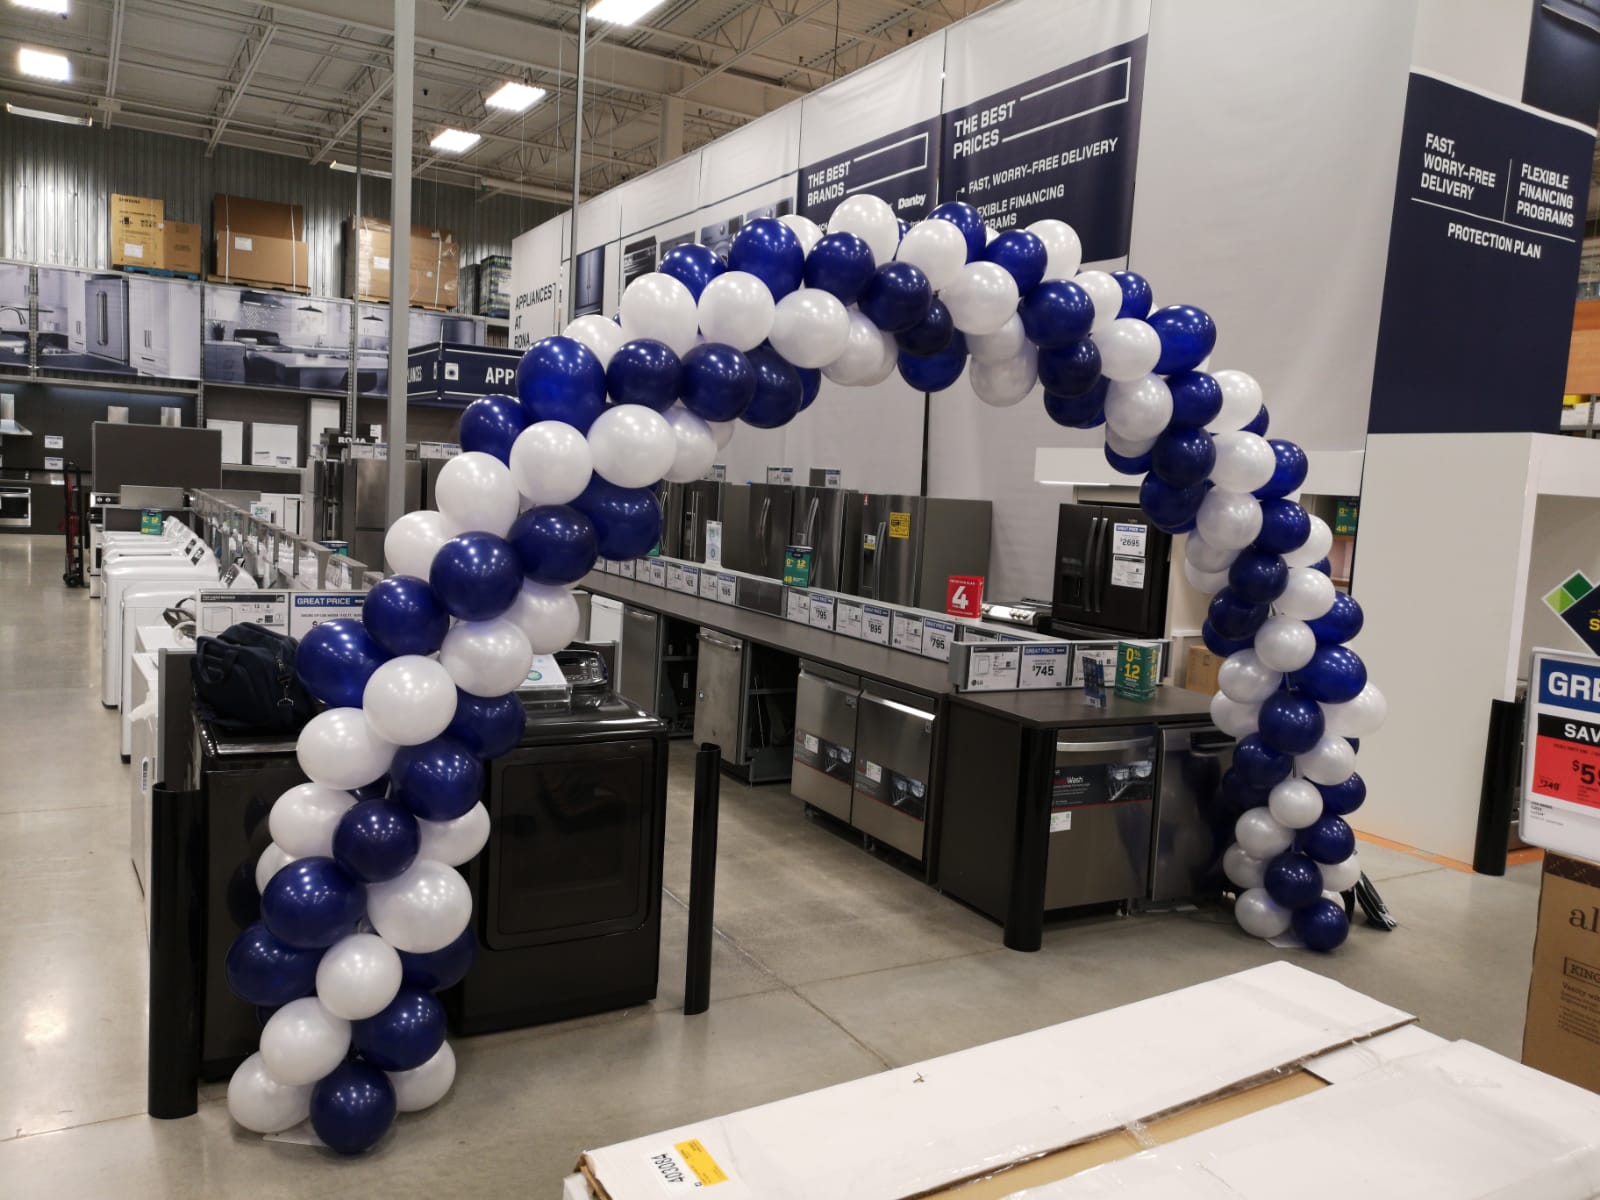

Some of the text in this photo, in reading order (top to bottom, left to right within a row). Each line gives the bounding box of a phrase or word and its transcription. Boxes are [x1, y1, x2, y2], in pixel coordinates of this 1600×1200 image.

[953, 100, 1016, 138] THE BEST
[953, 129, 999, 160] PRICES
[1425, 133, 1456, 158] FAST,
[808, 160, 851, 189] THE BEST
[968, 137, 1118, 195] FAST, WORRY-FREE DELIVERY
[1423, 153, 1497, 188] WORRY-FREE
[1521, 163, 1570, 190] FLEXIBLE
[807, 182, 845, 207] BRANDS
[1009, 184, 1064, 210] FINANCING
[1420, 172, 1475, 201] DELIVERY
[1518, 182, 1574, 210] FINANCING
[897, 193, 927, 210] Danby
[1516, 200, 1575, 229] PROGRAMS
[1447, 222, 1542, 260] PROTECTION PLAN
[515, 285, 553, 311] APPLIANCES
[514, 314, 522, 330] AT
[485, 366, 517, 385] APP
[297, 597, 351, 605] GREAT PRICE
[951, 585, 969, 610] 4
[1572, 759, 1600, 786] $5
